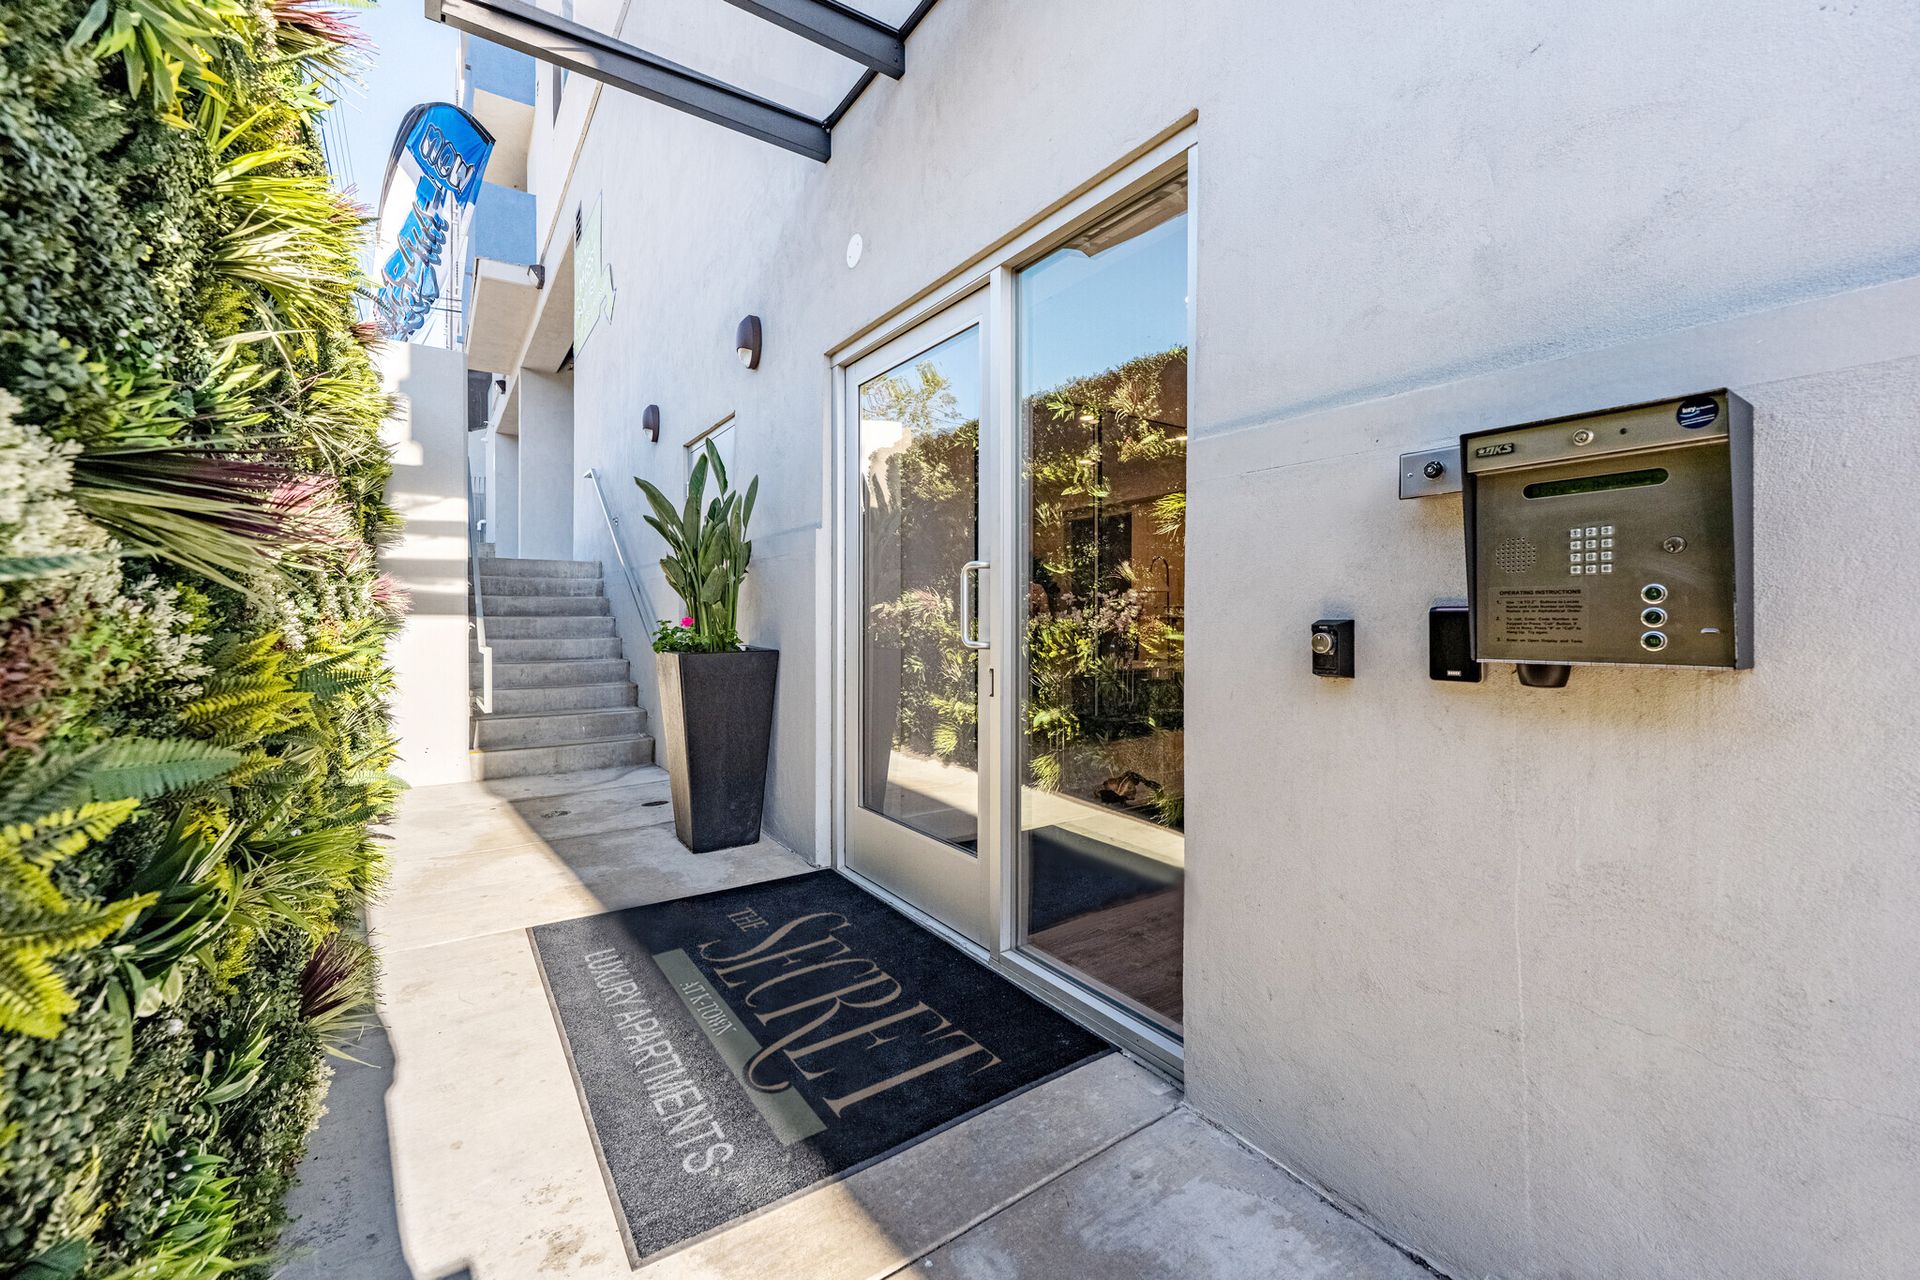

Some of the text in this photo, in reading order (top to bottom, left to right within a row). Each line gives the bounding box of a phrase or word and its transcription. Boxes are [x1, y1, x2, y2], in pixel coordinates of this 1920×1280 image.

[727, 906, 769, 932] THE
[584, 947, 734, 1175] LUXURY APARTMENTS
[679, 981, 737, 1036] AT K-TOWN
[698, 911, 1002, 1119] SECRET
